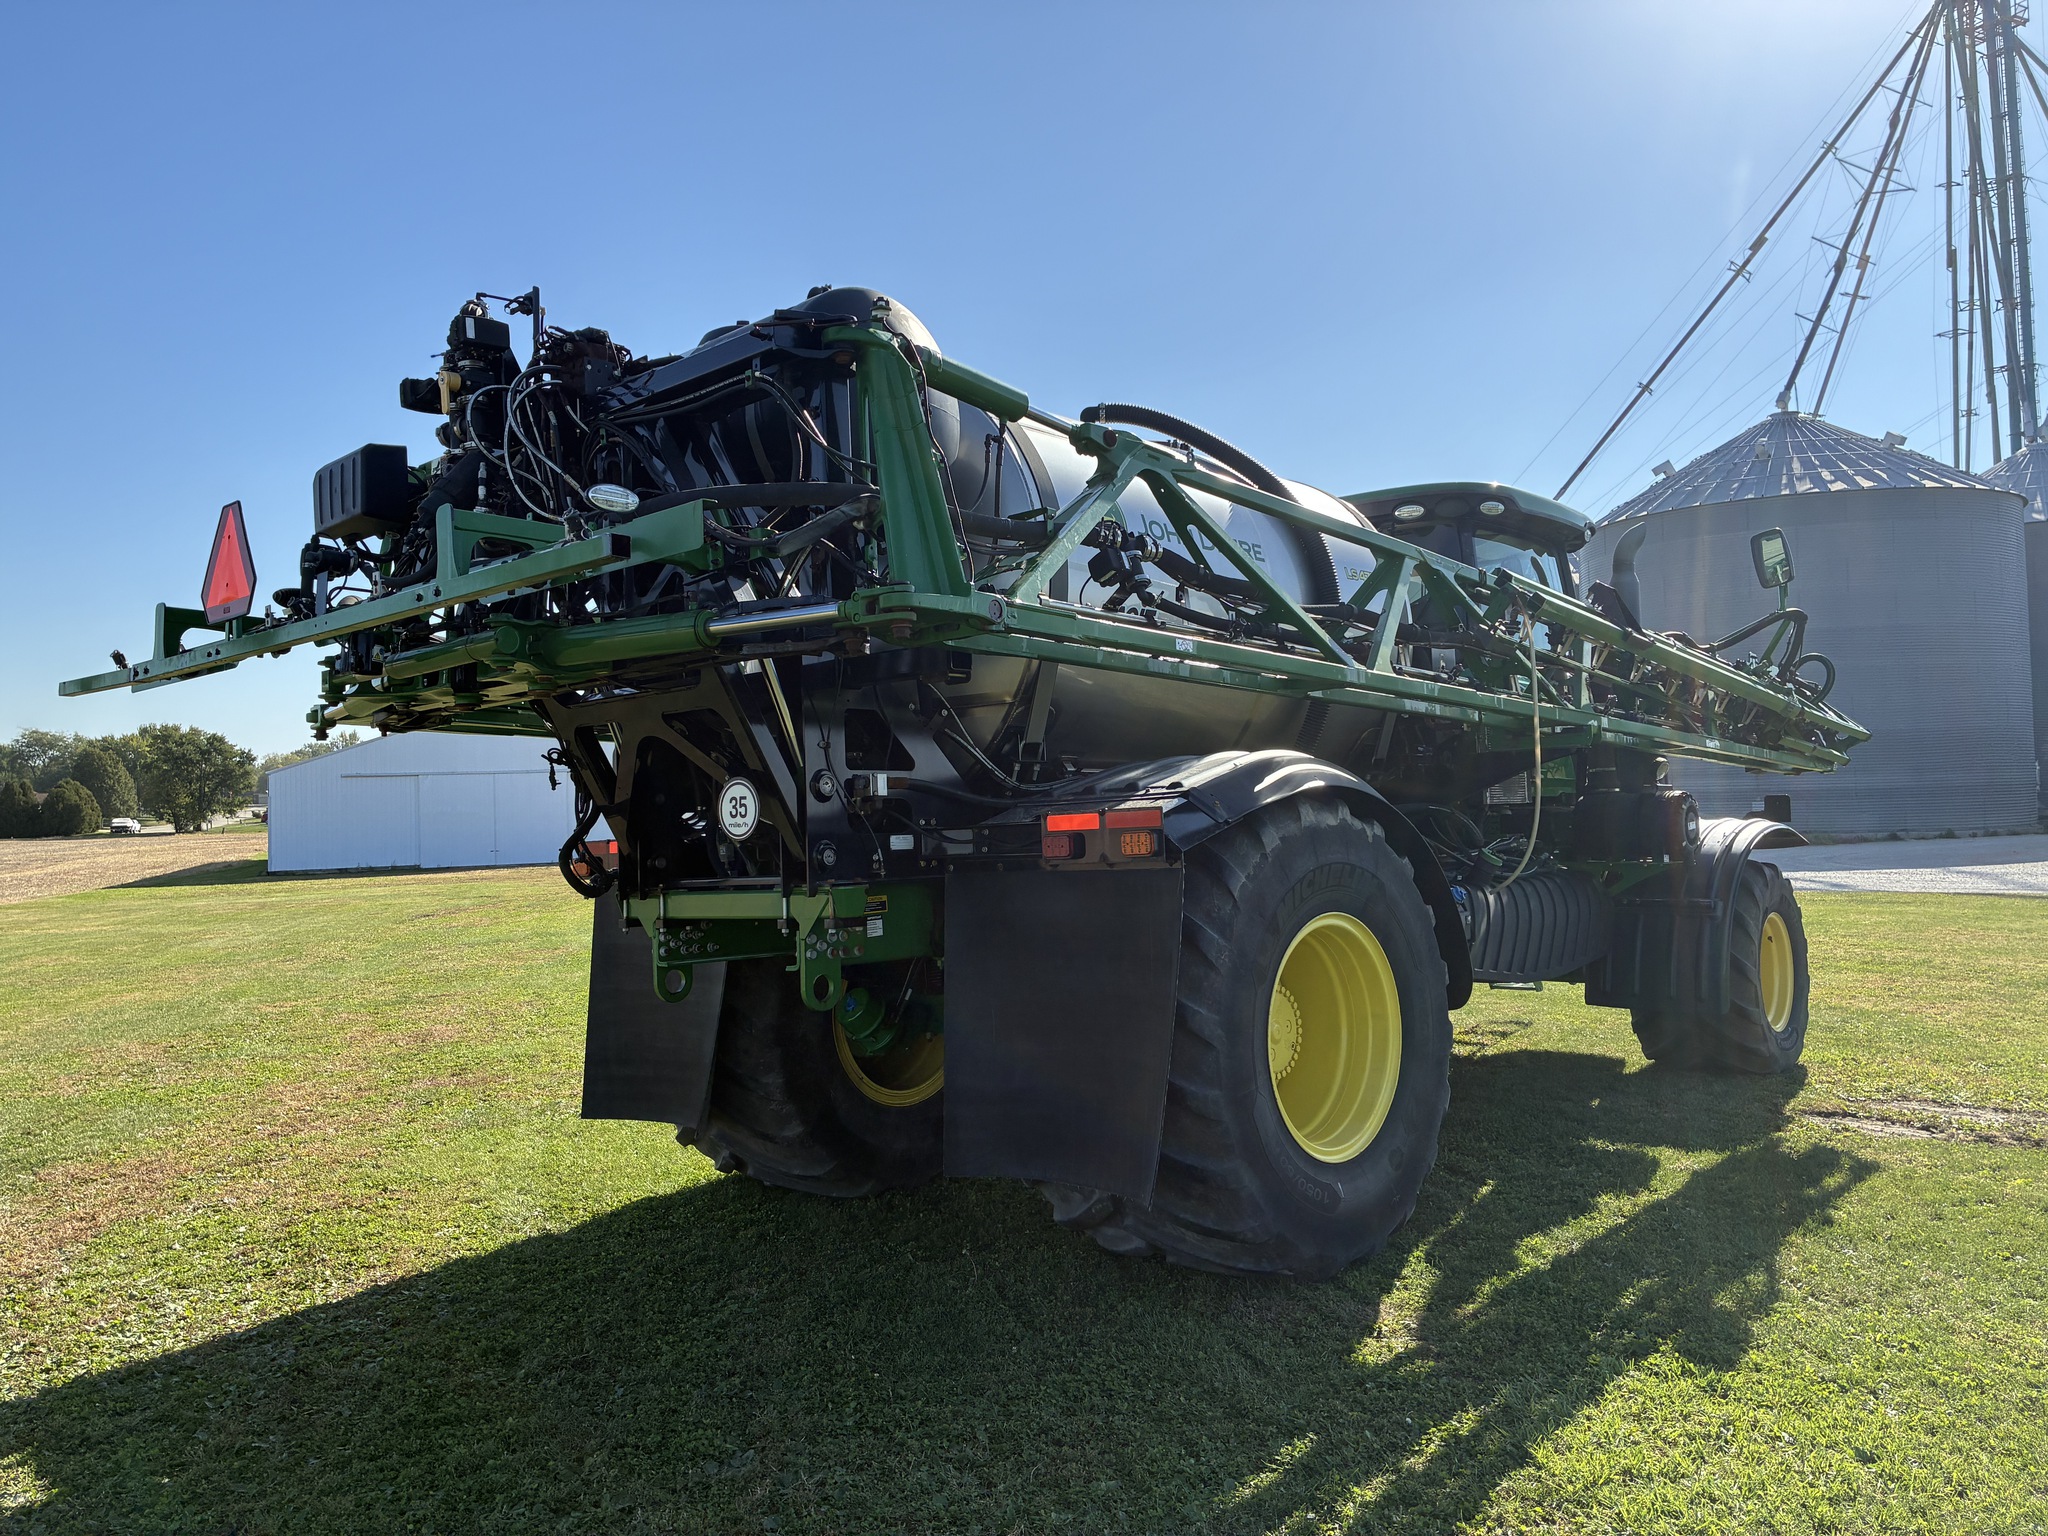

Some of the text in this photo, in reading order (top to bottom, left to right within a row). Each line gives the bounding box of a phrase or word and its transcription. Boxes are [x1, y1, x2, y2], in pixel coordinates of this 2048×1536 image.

[1137, 513, 1266, 563] JOH DRE
[729, 795, 748, 819] 35
